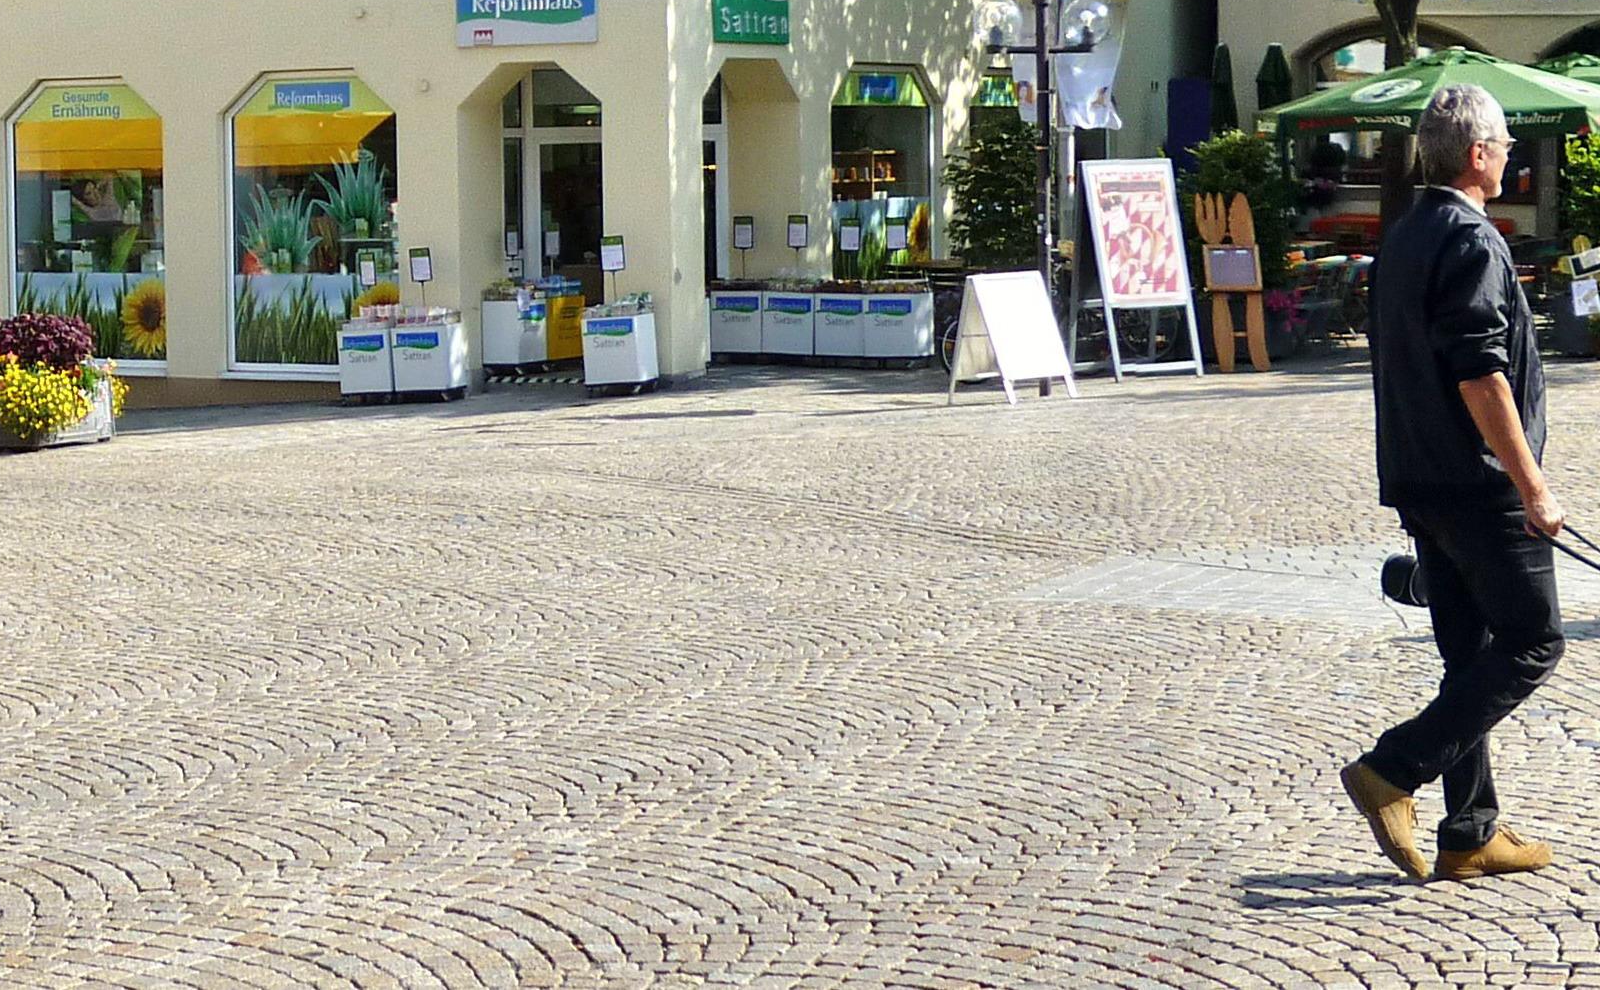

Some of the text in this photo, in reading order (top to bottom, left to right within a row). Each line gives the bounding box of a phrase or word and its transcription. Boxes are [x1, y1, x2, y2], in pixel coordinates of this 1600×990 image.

[62, 90, 110, 104] Gesunde
[276, 90, 344, 107] Reformhaus
[51, 103, 121, 119] Ernährung
